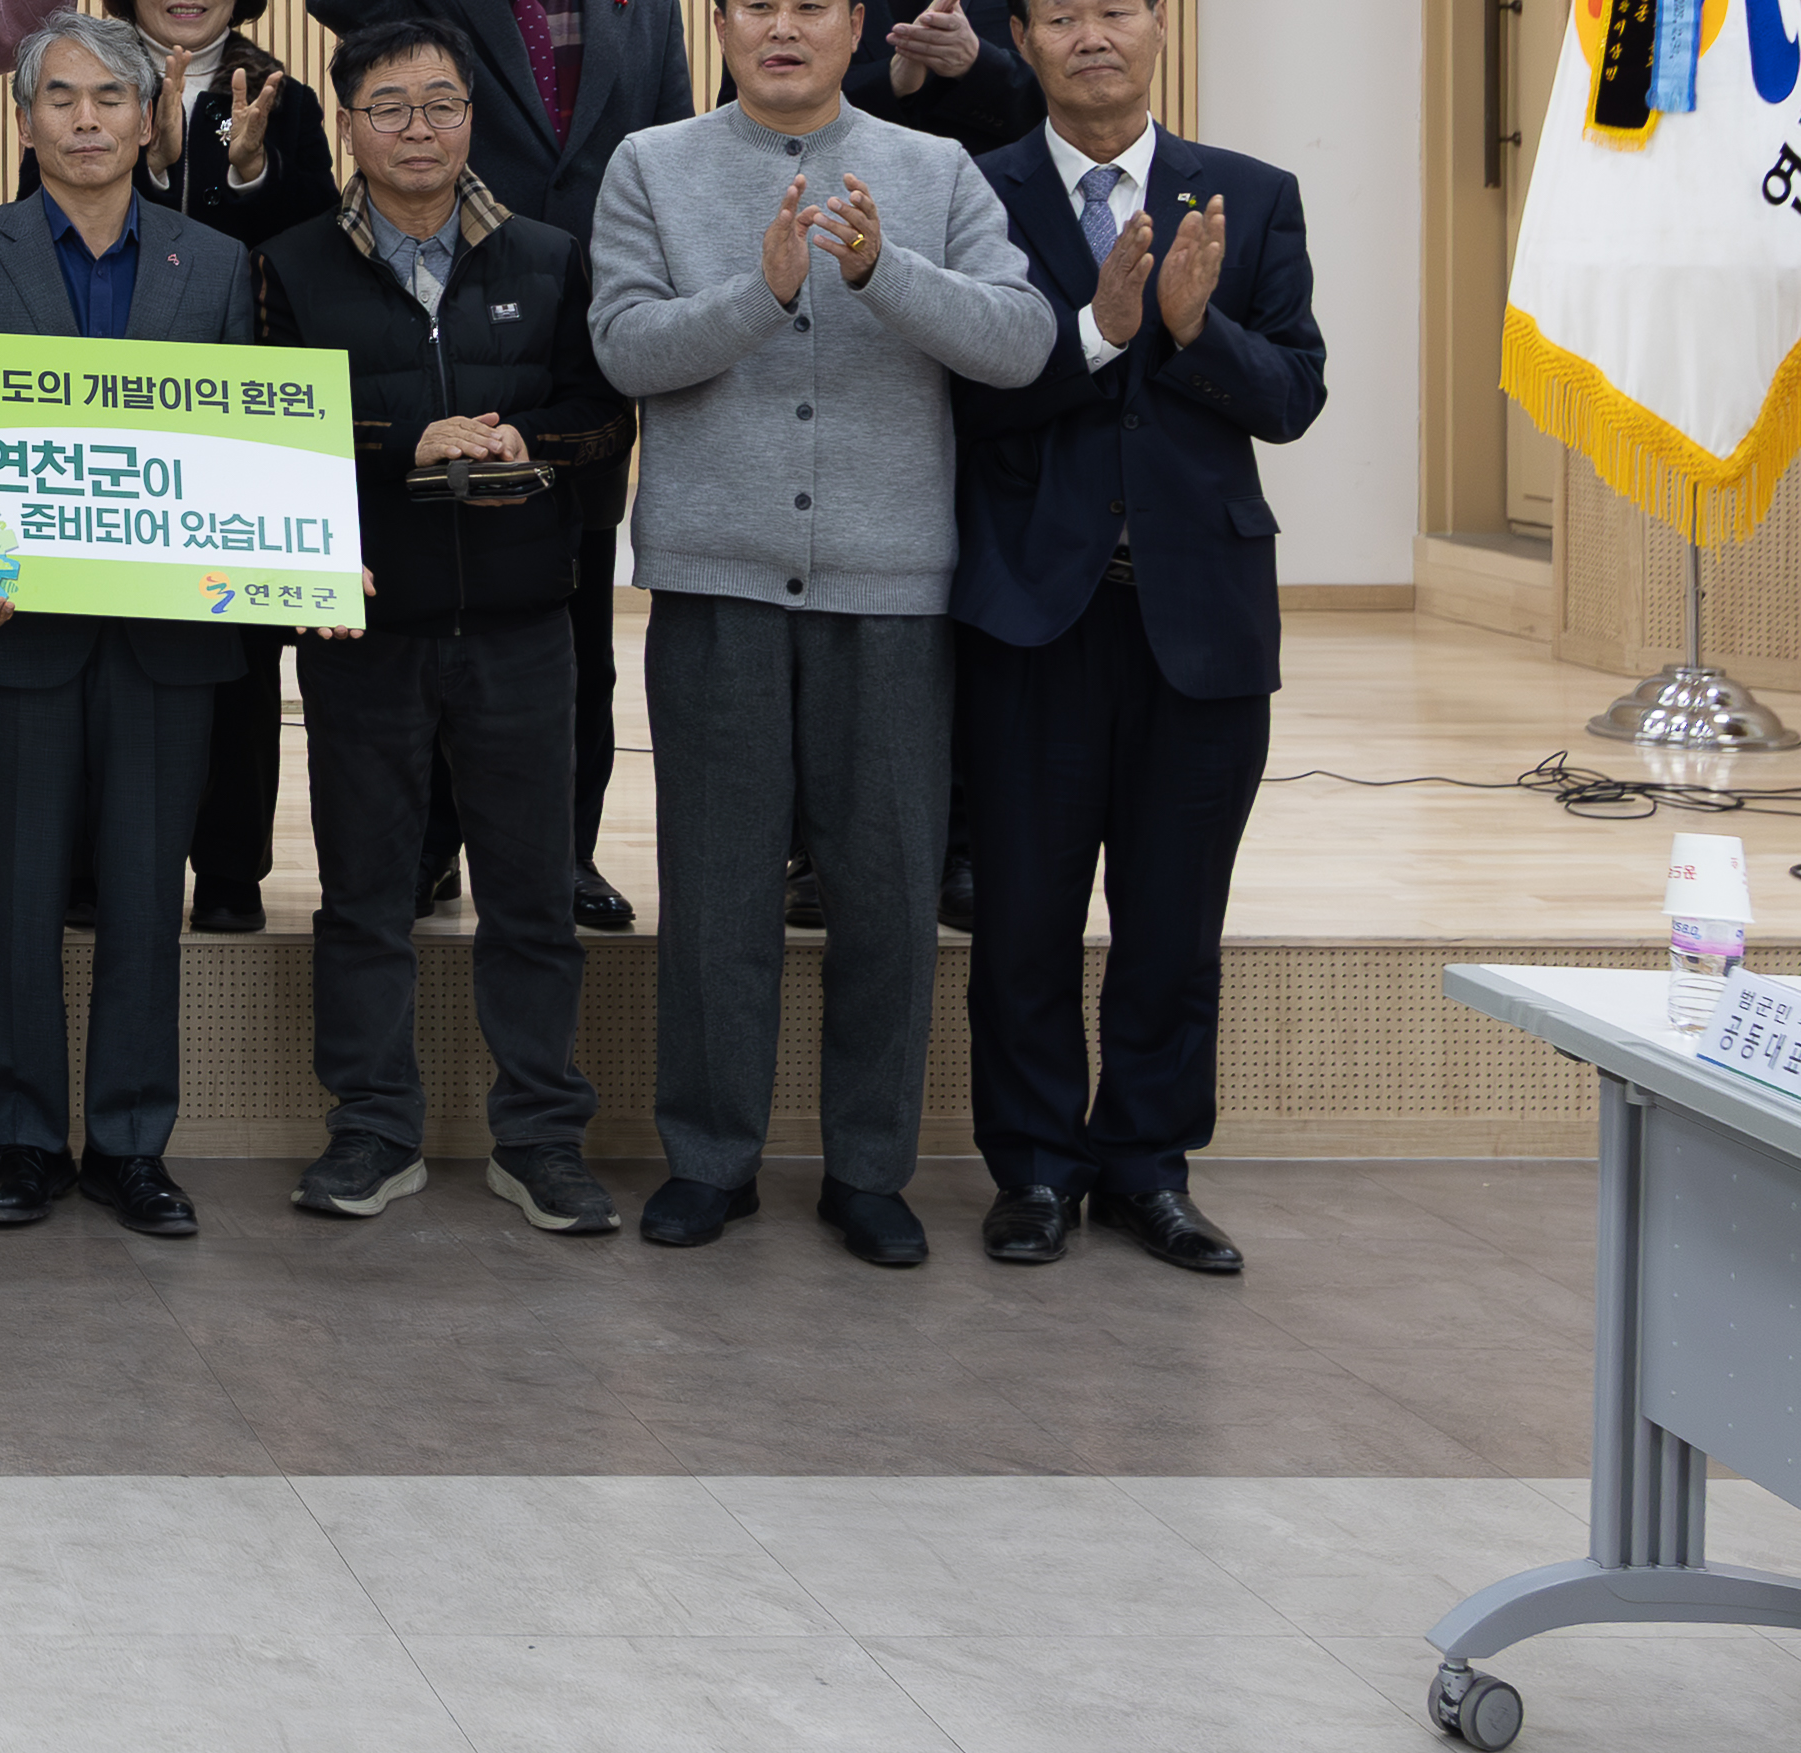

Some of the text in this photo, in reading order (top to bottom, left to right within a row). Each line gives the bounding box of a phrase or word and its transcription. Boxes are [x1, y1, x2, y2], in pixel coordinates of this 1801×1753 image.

[83, 372, 229, 414] 개발이익
[241, 380, 326, 419] 환원,
[20, 502, 334, 556] 준비되어 있습니다
[244, 584, 337, 610] 연천군
[1739, 989, 1793, 1026] 범군민
